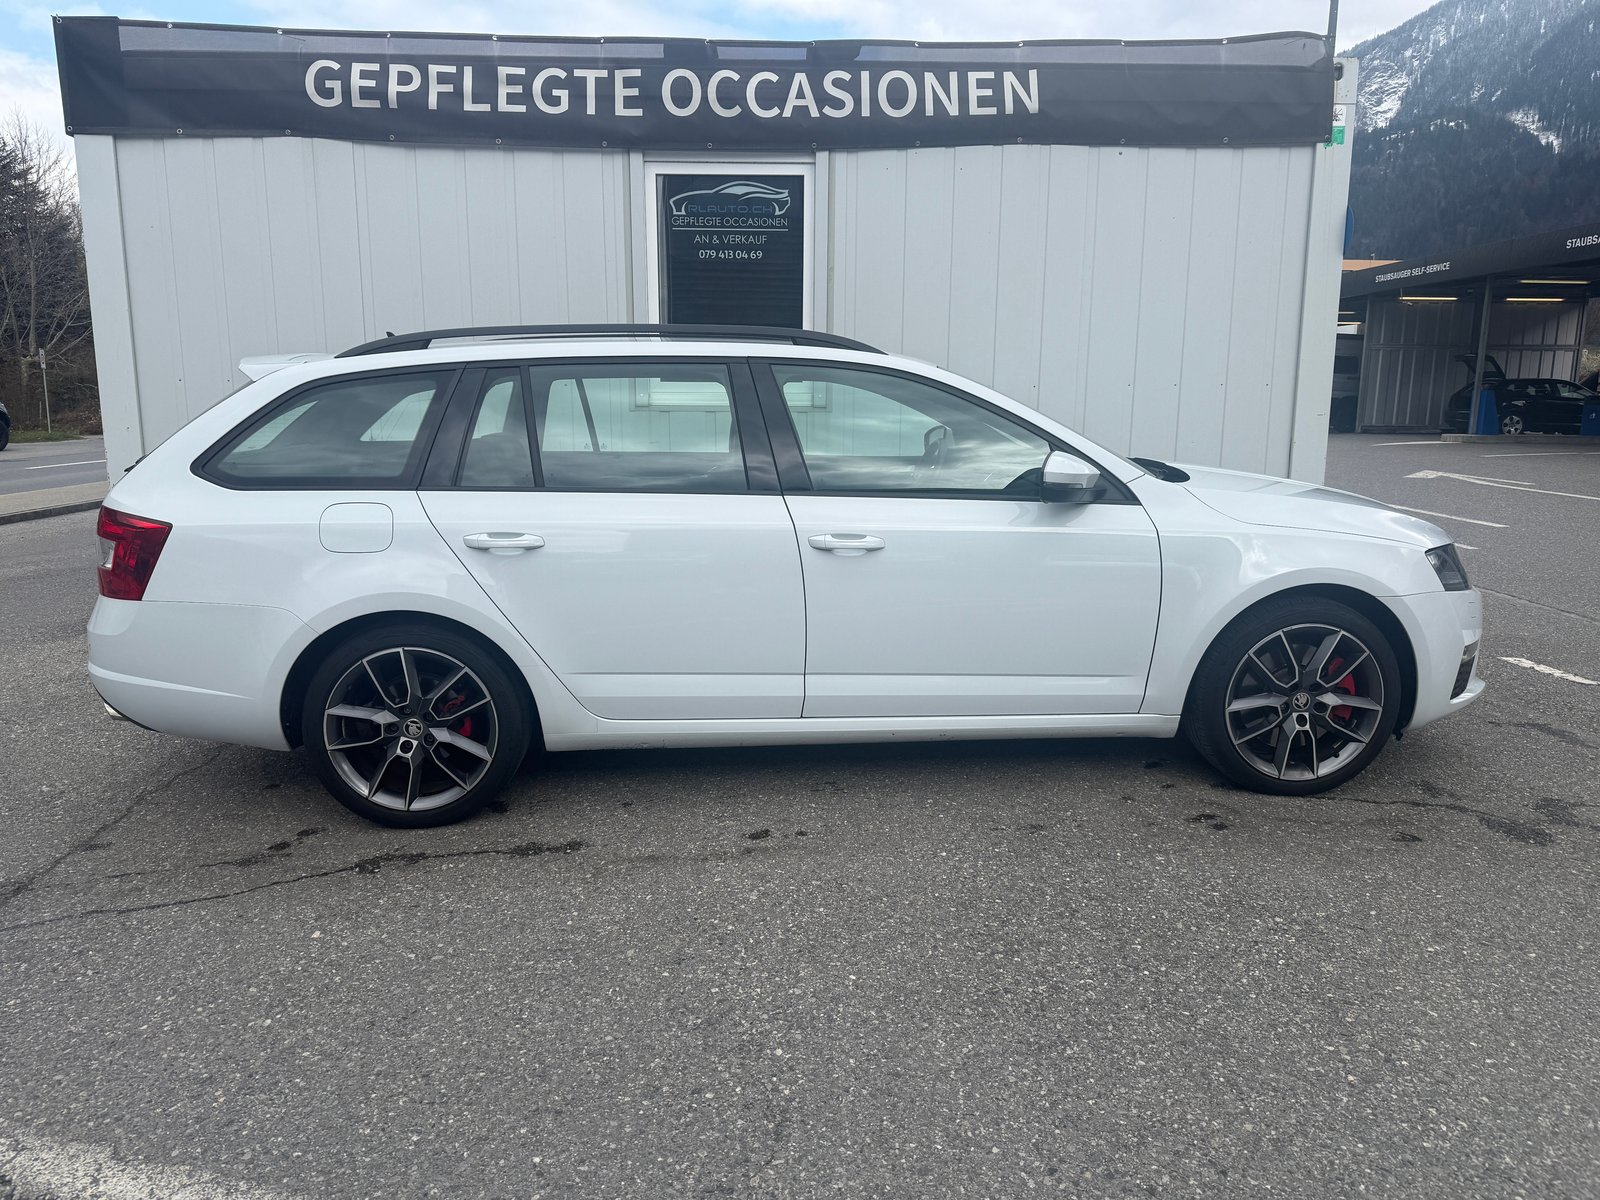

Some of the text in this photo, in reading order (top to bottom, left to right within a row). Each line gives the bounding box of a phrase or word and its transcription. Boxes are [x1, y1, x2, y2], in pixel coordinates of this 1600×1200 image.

[304, 59, 1040, 119] GEPFLEGTE OCCASIONEN
[688, 204, 773, 214] RLAUTO.CH
[671, 216, 788, 227] GEPFLEGTE OCCASIONEN
[693, 234, 768, 244] AN & VERKAUF
[699, 249, 763, 259] 079 413 04 69
[1375, 261, 1451, 283] STAUBSAUGER SELF-SERVICE
